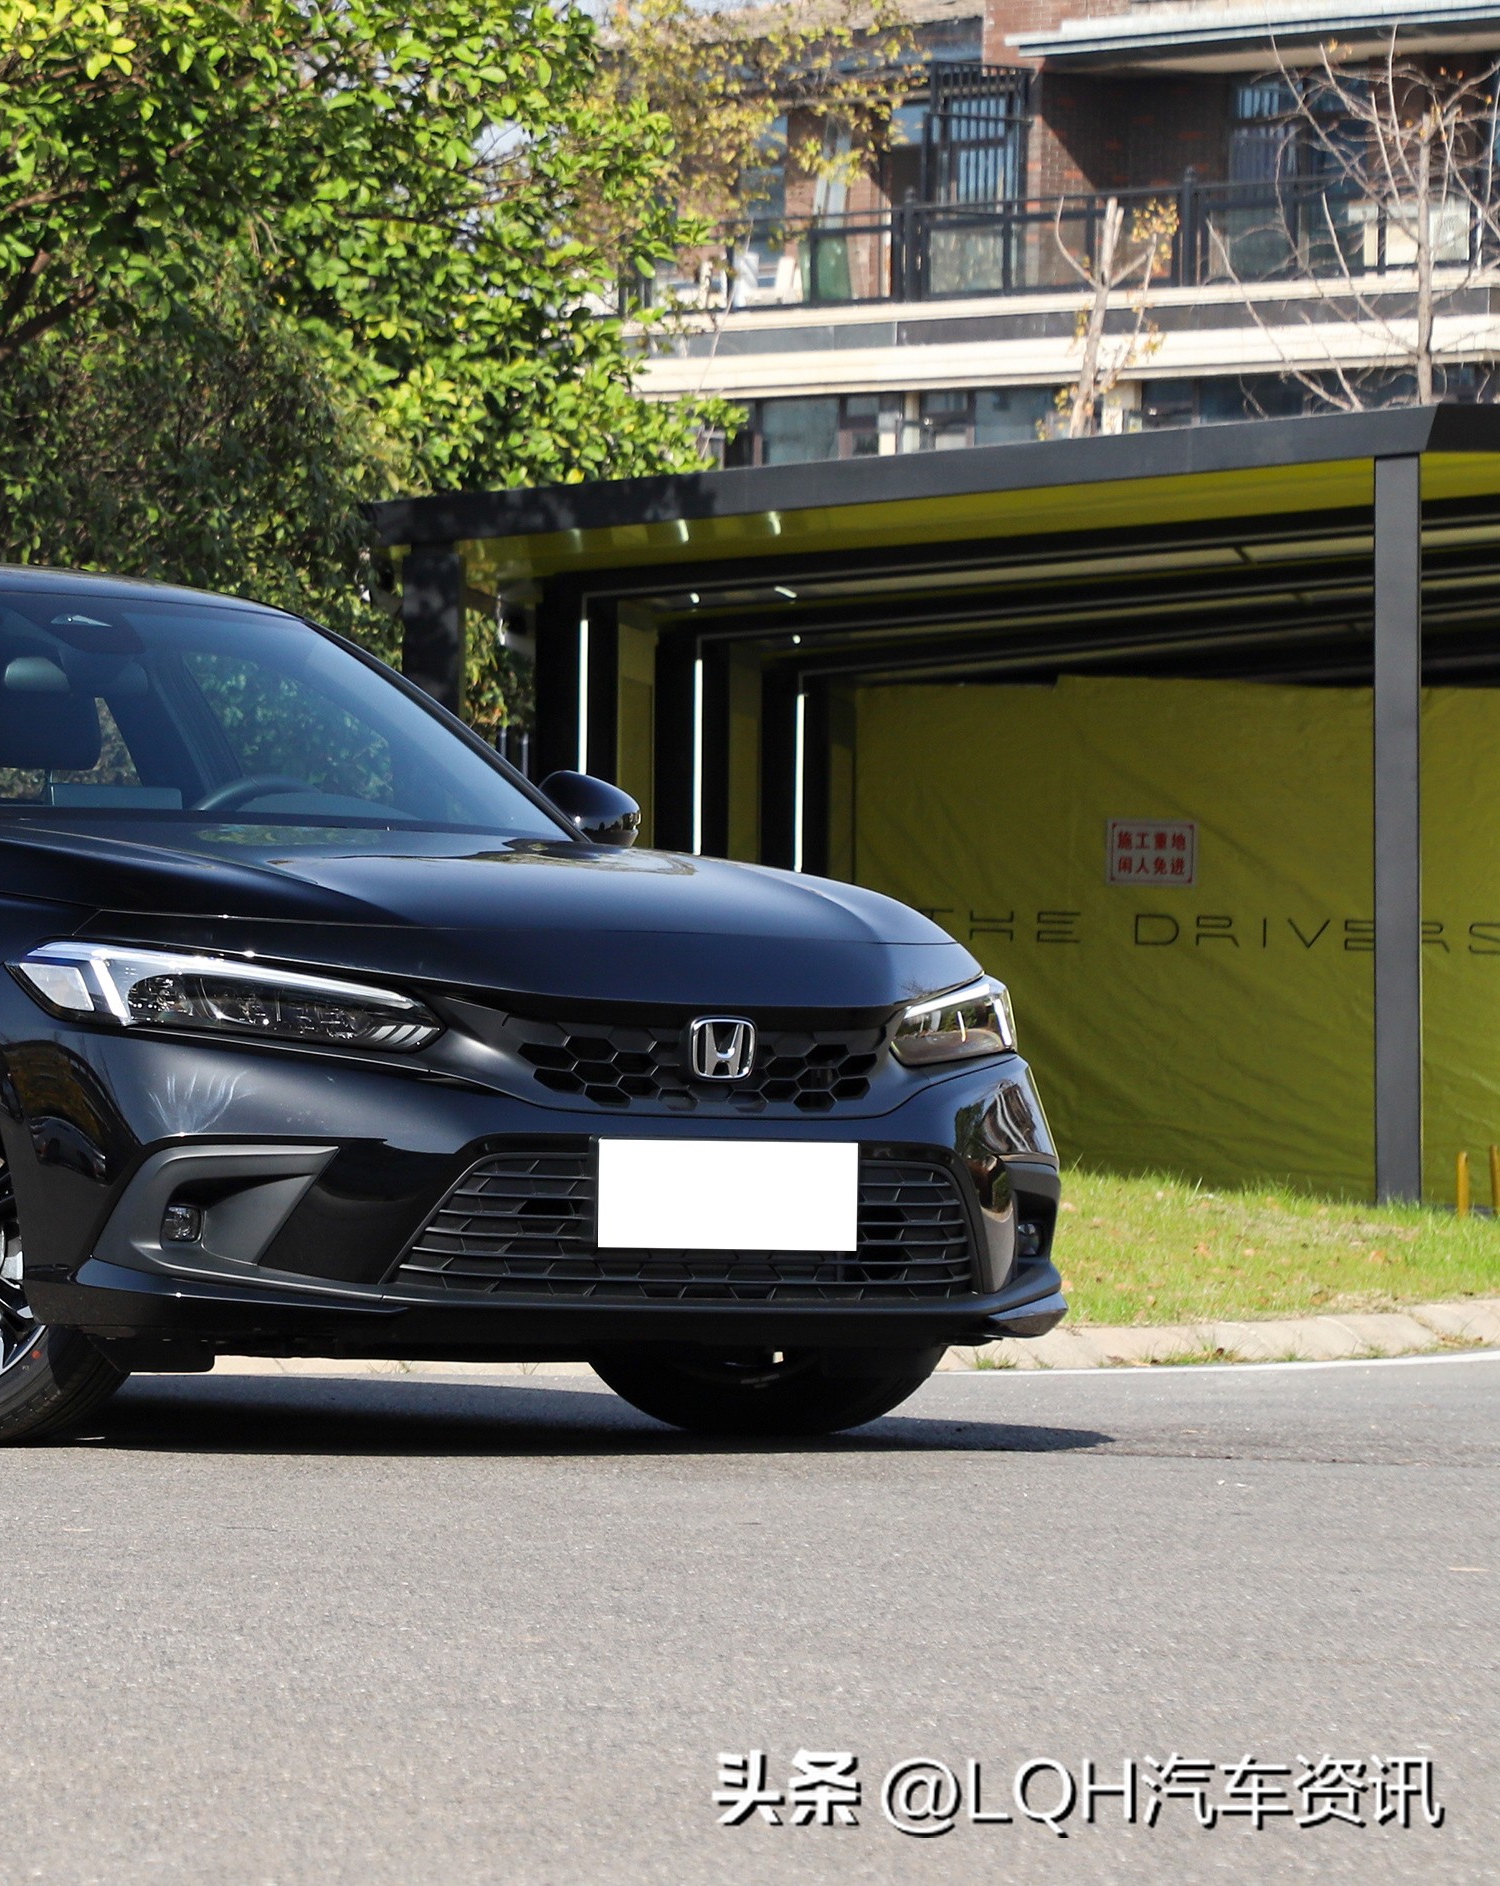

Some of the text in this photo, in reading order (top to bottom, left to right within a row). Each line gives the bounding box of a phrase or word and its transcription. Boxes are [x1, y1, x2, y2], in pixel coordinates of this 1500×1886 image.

[1117, 831, 1186, 851] 施工重地
[1117, 855, 1185, 876] 闲人免进
